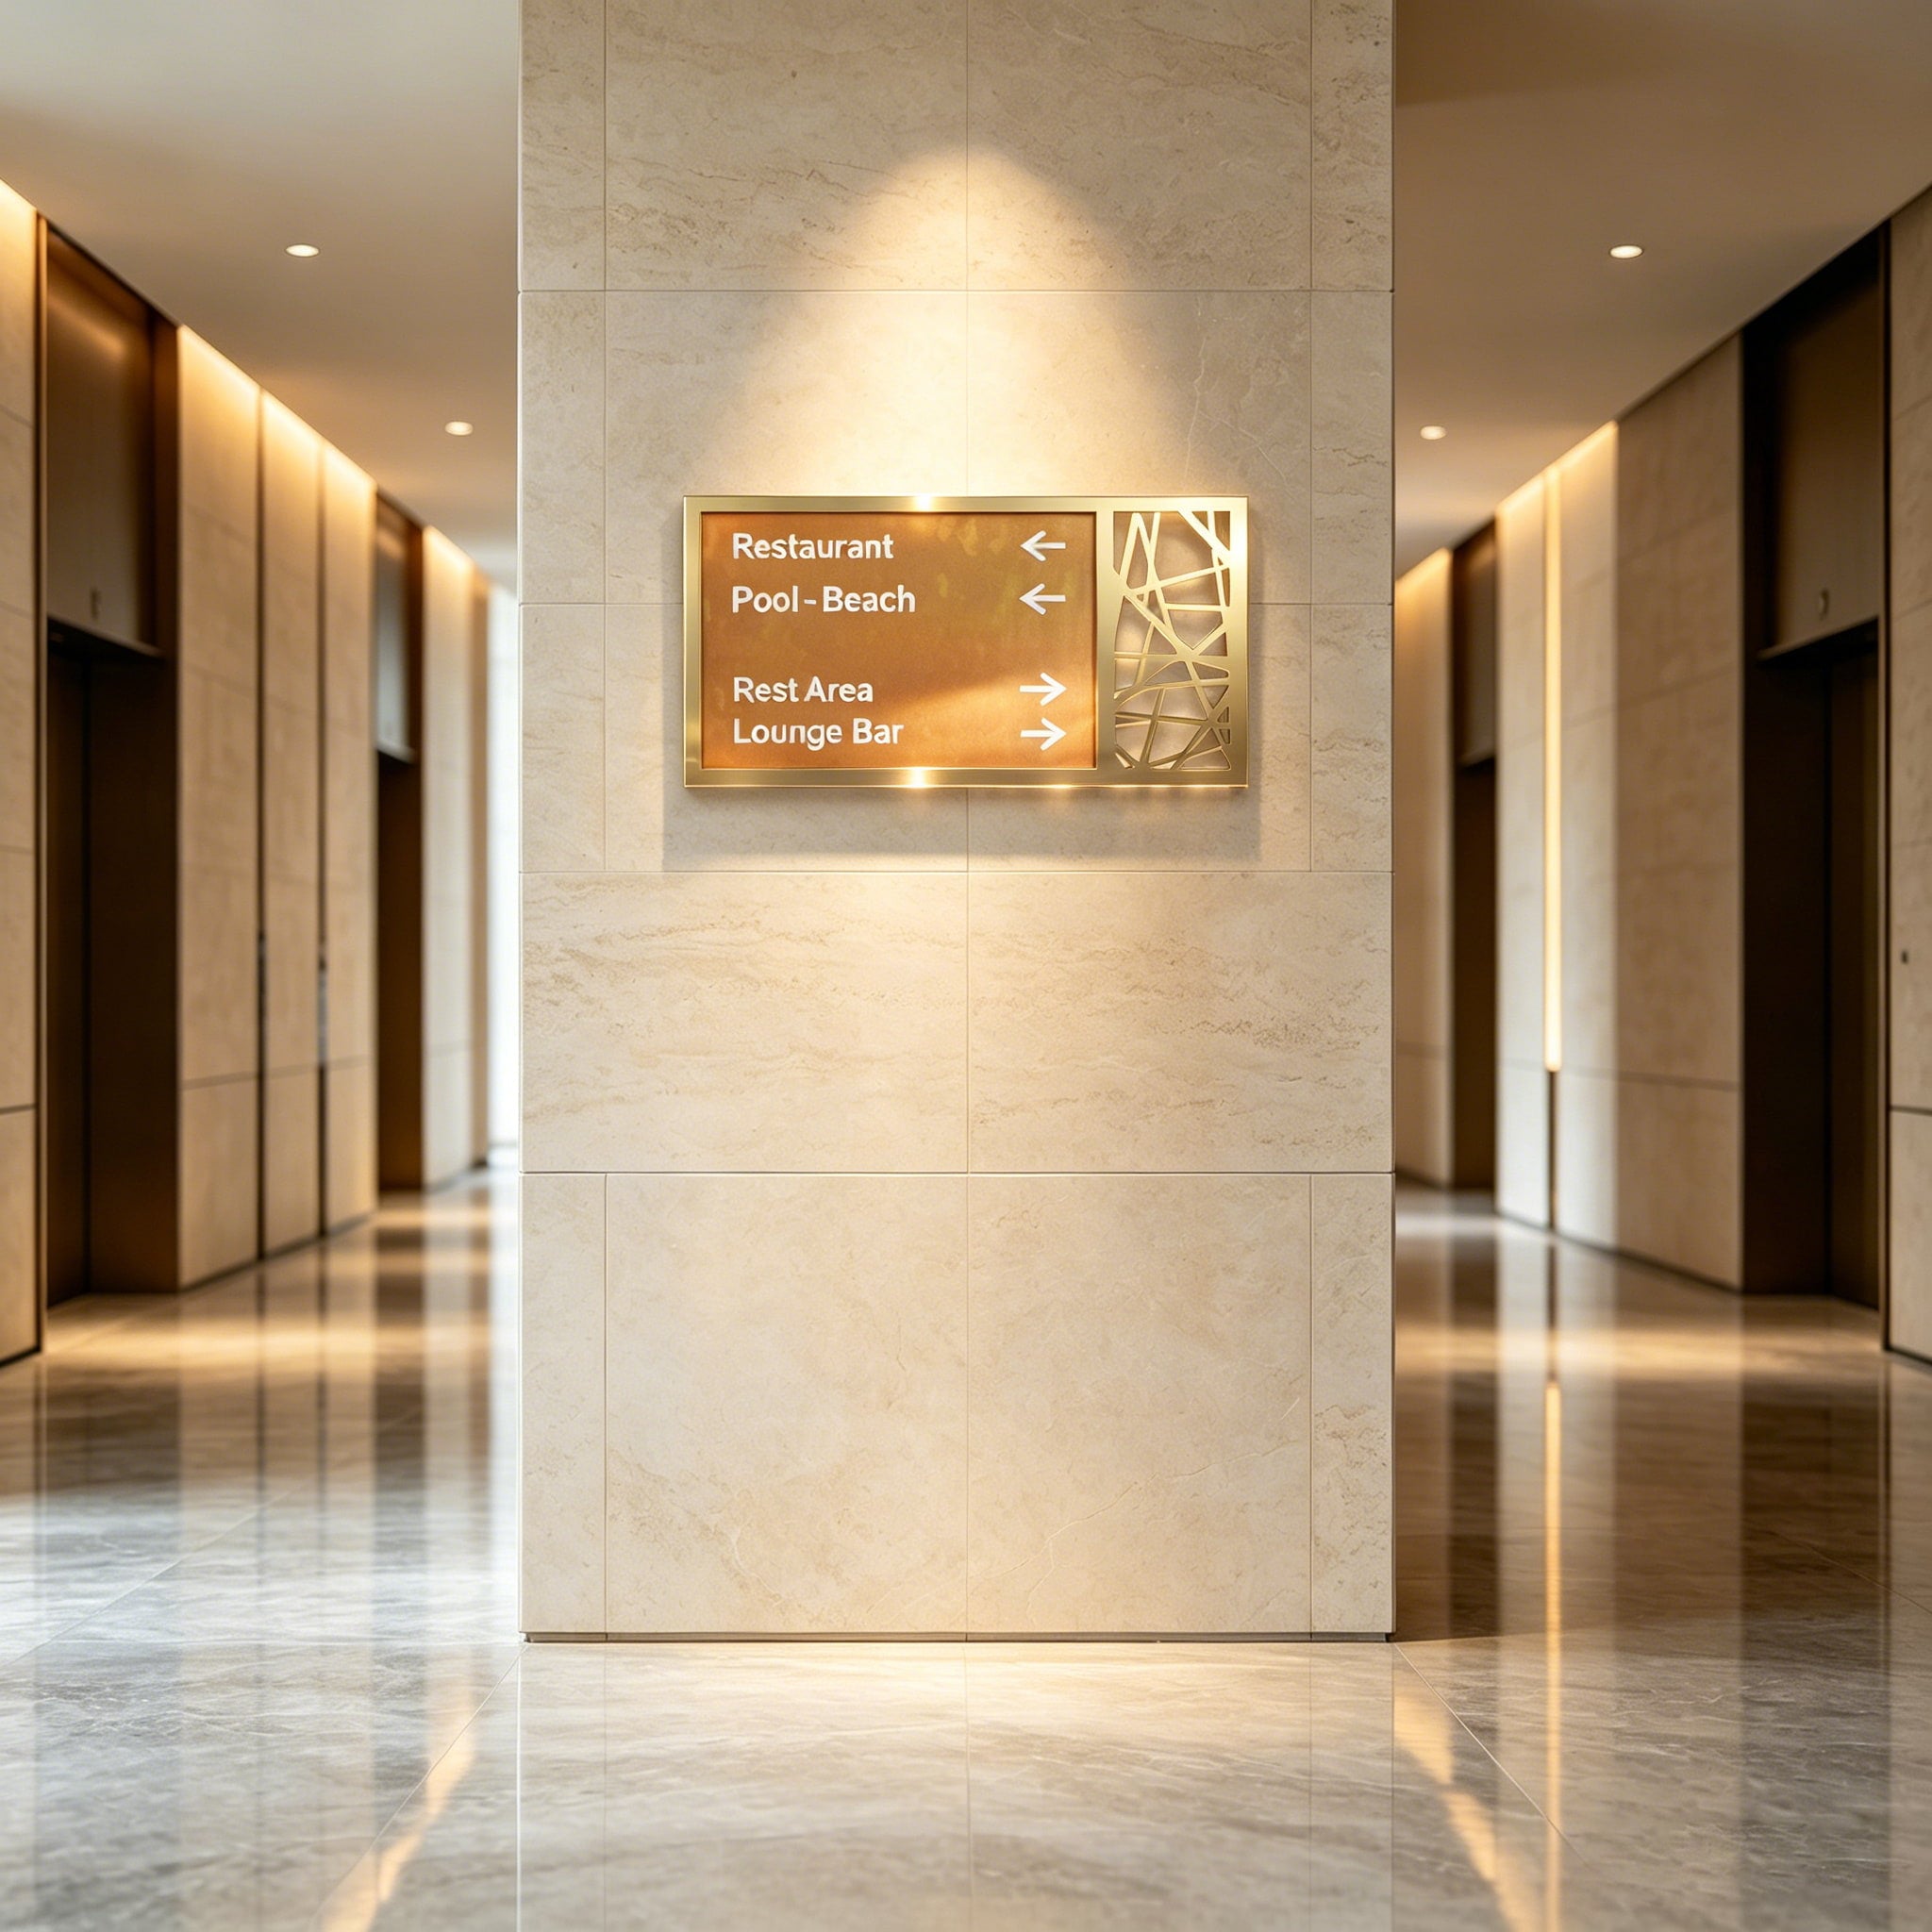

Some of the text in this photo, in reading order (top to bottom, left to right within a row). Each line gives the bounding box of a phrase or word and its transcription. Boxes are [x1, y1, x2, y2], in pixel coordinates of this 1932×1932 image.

[732, 532, 894, 559] Restaurant
[732, 585, 799, 613] Pool
[823, 584, 916, 613] Beach
[733, 675, 874, 703] Rest Area
[733, 717, 905, 751] Lounge Bar
